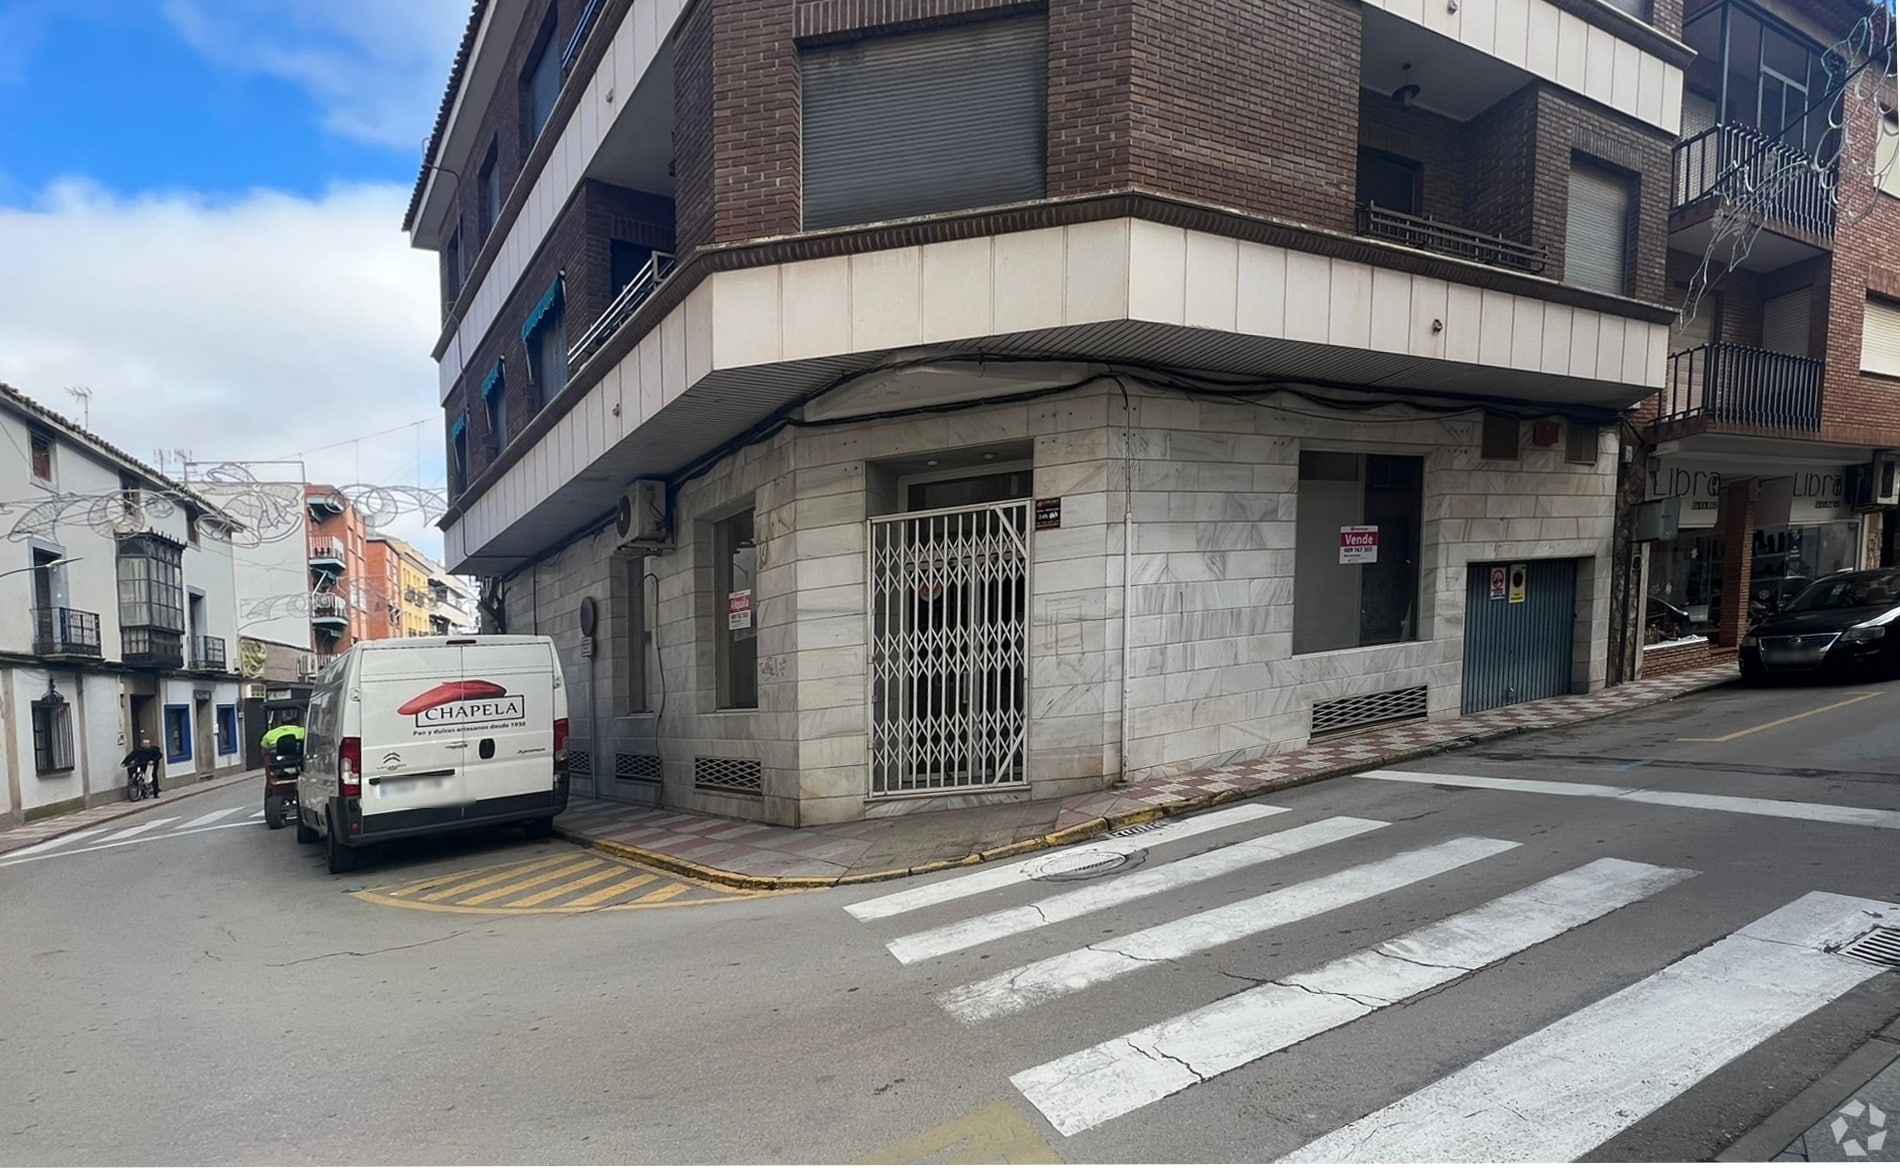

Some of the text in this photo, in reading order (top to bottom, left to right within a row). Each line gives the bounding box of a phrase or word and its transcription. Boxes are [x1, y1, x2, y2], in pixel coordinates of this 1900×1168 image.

[1344, 533, 1374, 545] Vende
[425, 702, 518, 720] CHAPELA
[456, 724, 488, 732] artesanos
